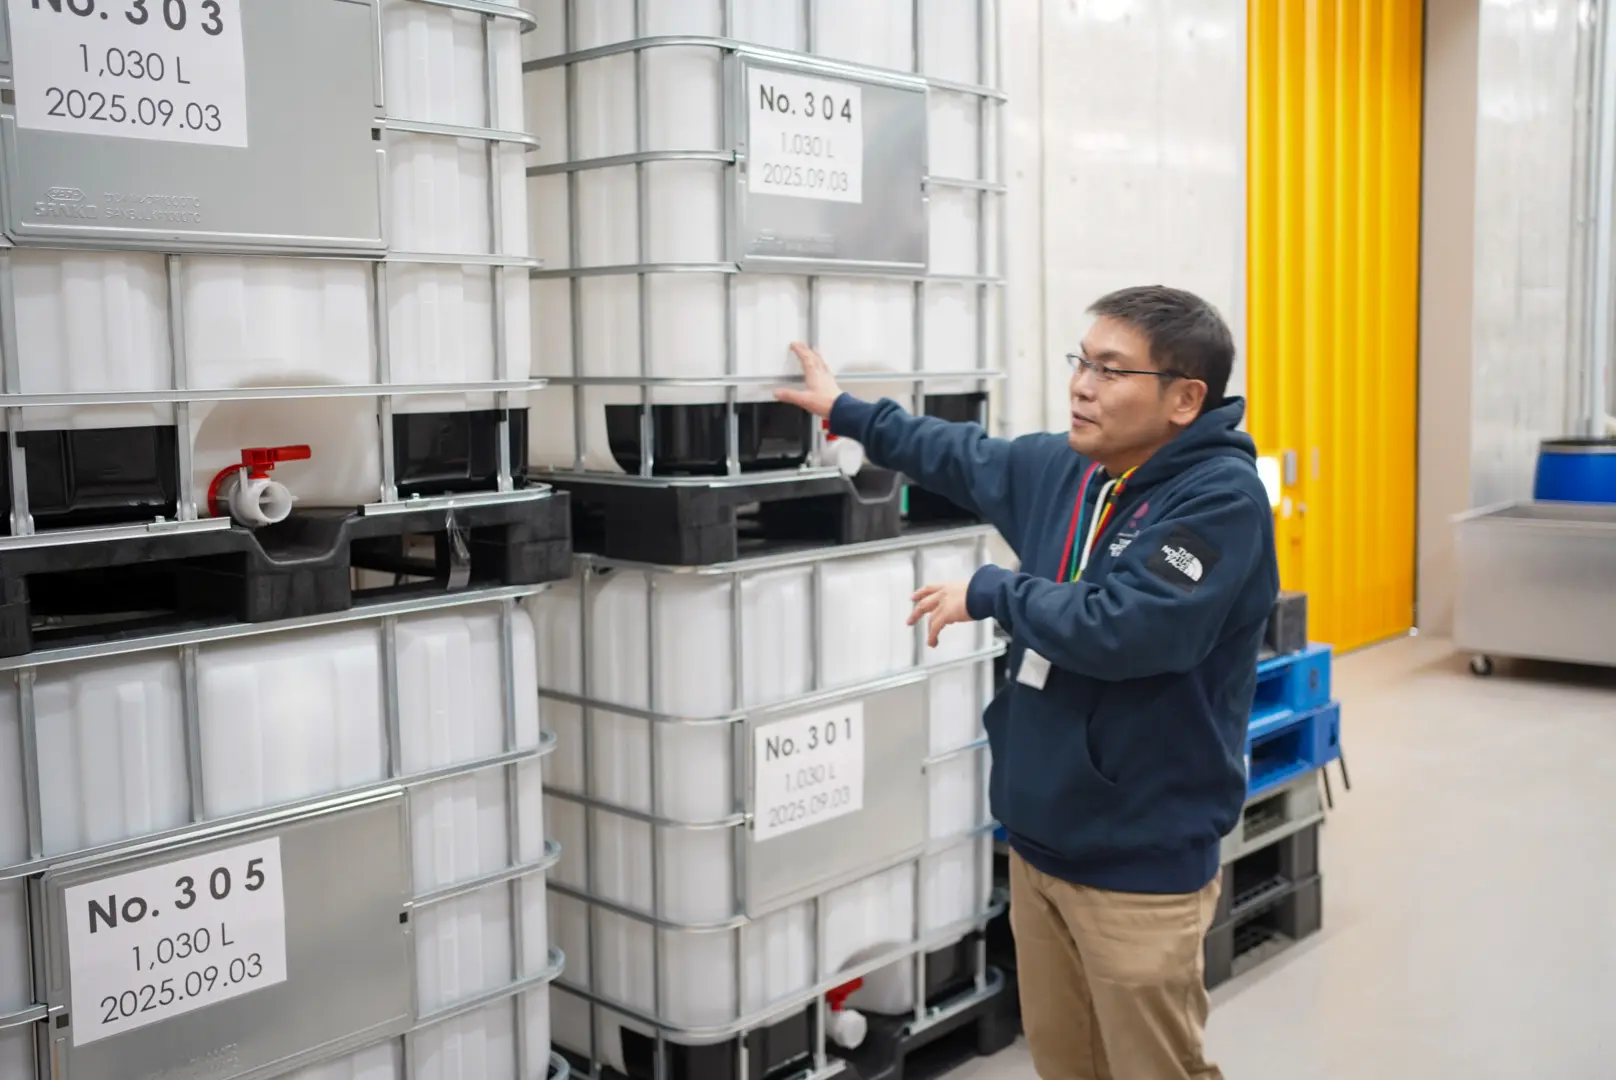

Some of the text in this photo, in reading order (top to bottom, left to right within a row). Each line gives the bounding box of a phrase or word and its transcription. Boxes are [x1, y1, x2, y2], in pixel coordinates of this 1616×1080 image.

[79, 44, 190, 84] 1,030 L
[45, 87, 222, 132] 2025.09.03
[760, 84, 796, 115] No.
[763, 163, 849, 191] 2025.09.03
[766, 736, 801, 762] No.
[768, 785, 851, 828] 2025.09.03
[88, 894, 160, 934] No.
[132, 922, 235, 972] 1,030 L
[99, 953, 264, 1024] 2025.09.03
